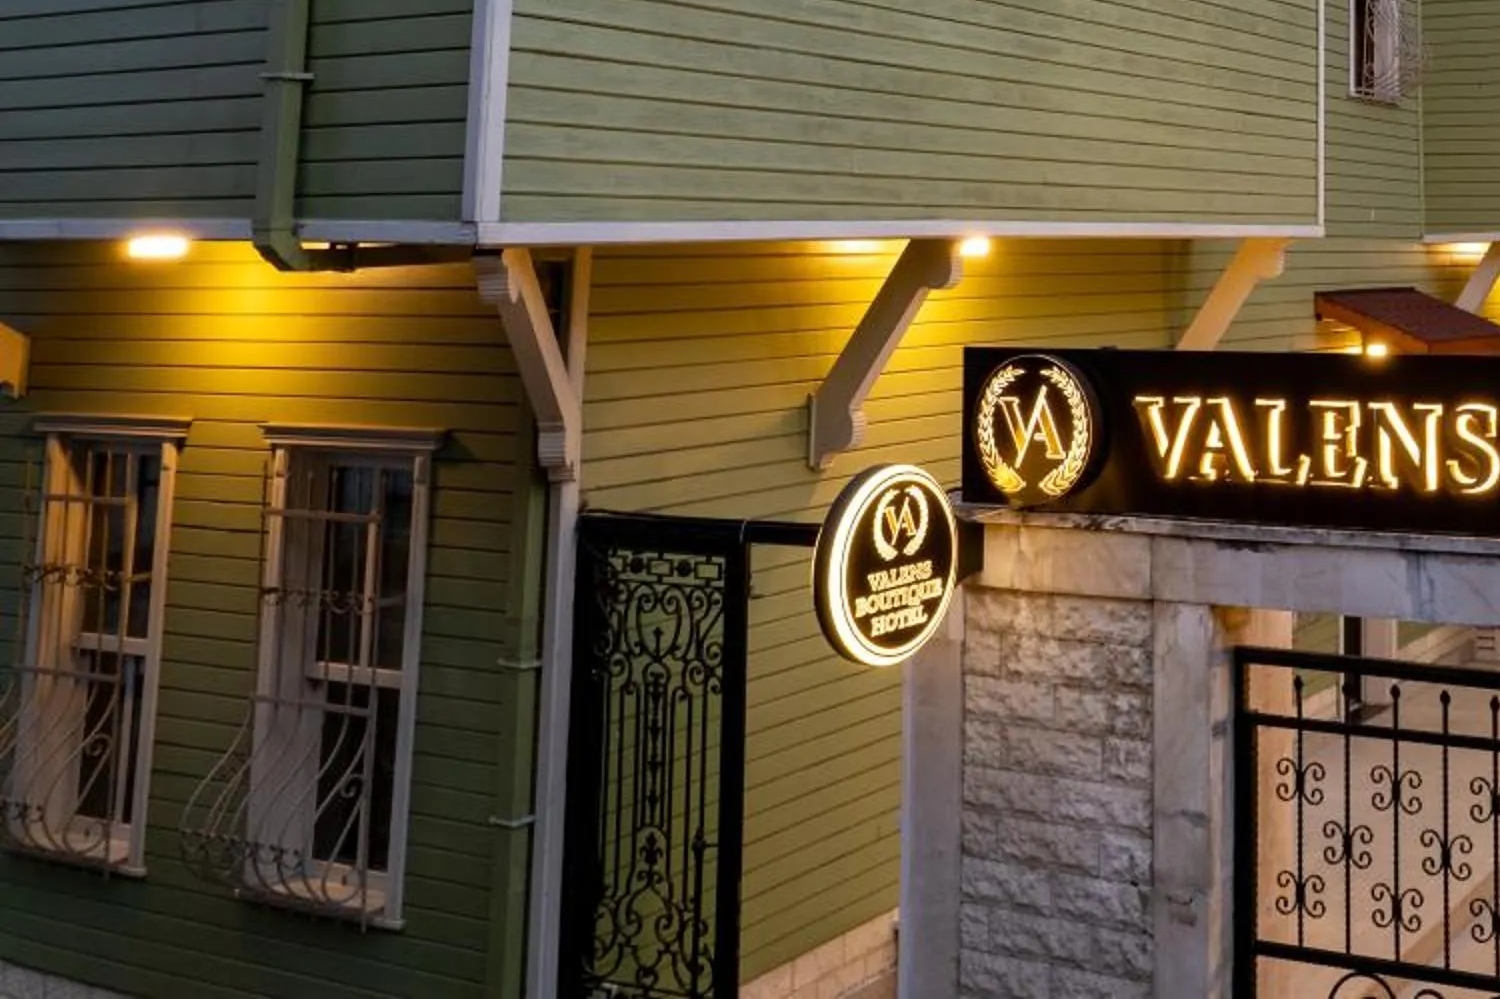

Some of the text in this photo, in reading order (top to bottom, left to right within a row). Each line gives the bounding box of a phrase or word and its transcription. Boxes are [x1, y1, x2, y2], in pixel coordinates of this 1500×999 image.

[1134, 394, 1500, 494] VALENS
[867, 560, 933, 592] VALENS
[855, 578, 943, 619] BOUTIQUE
[870, 605, 929, 637] HOTEL
